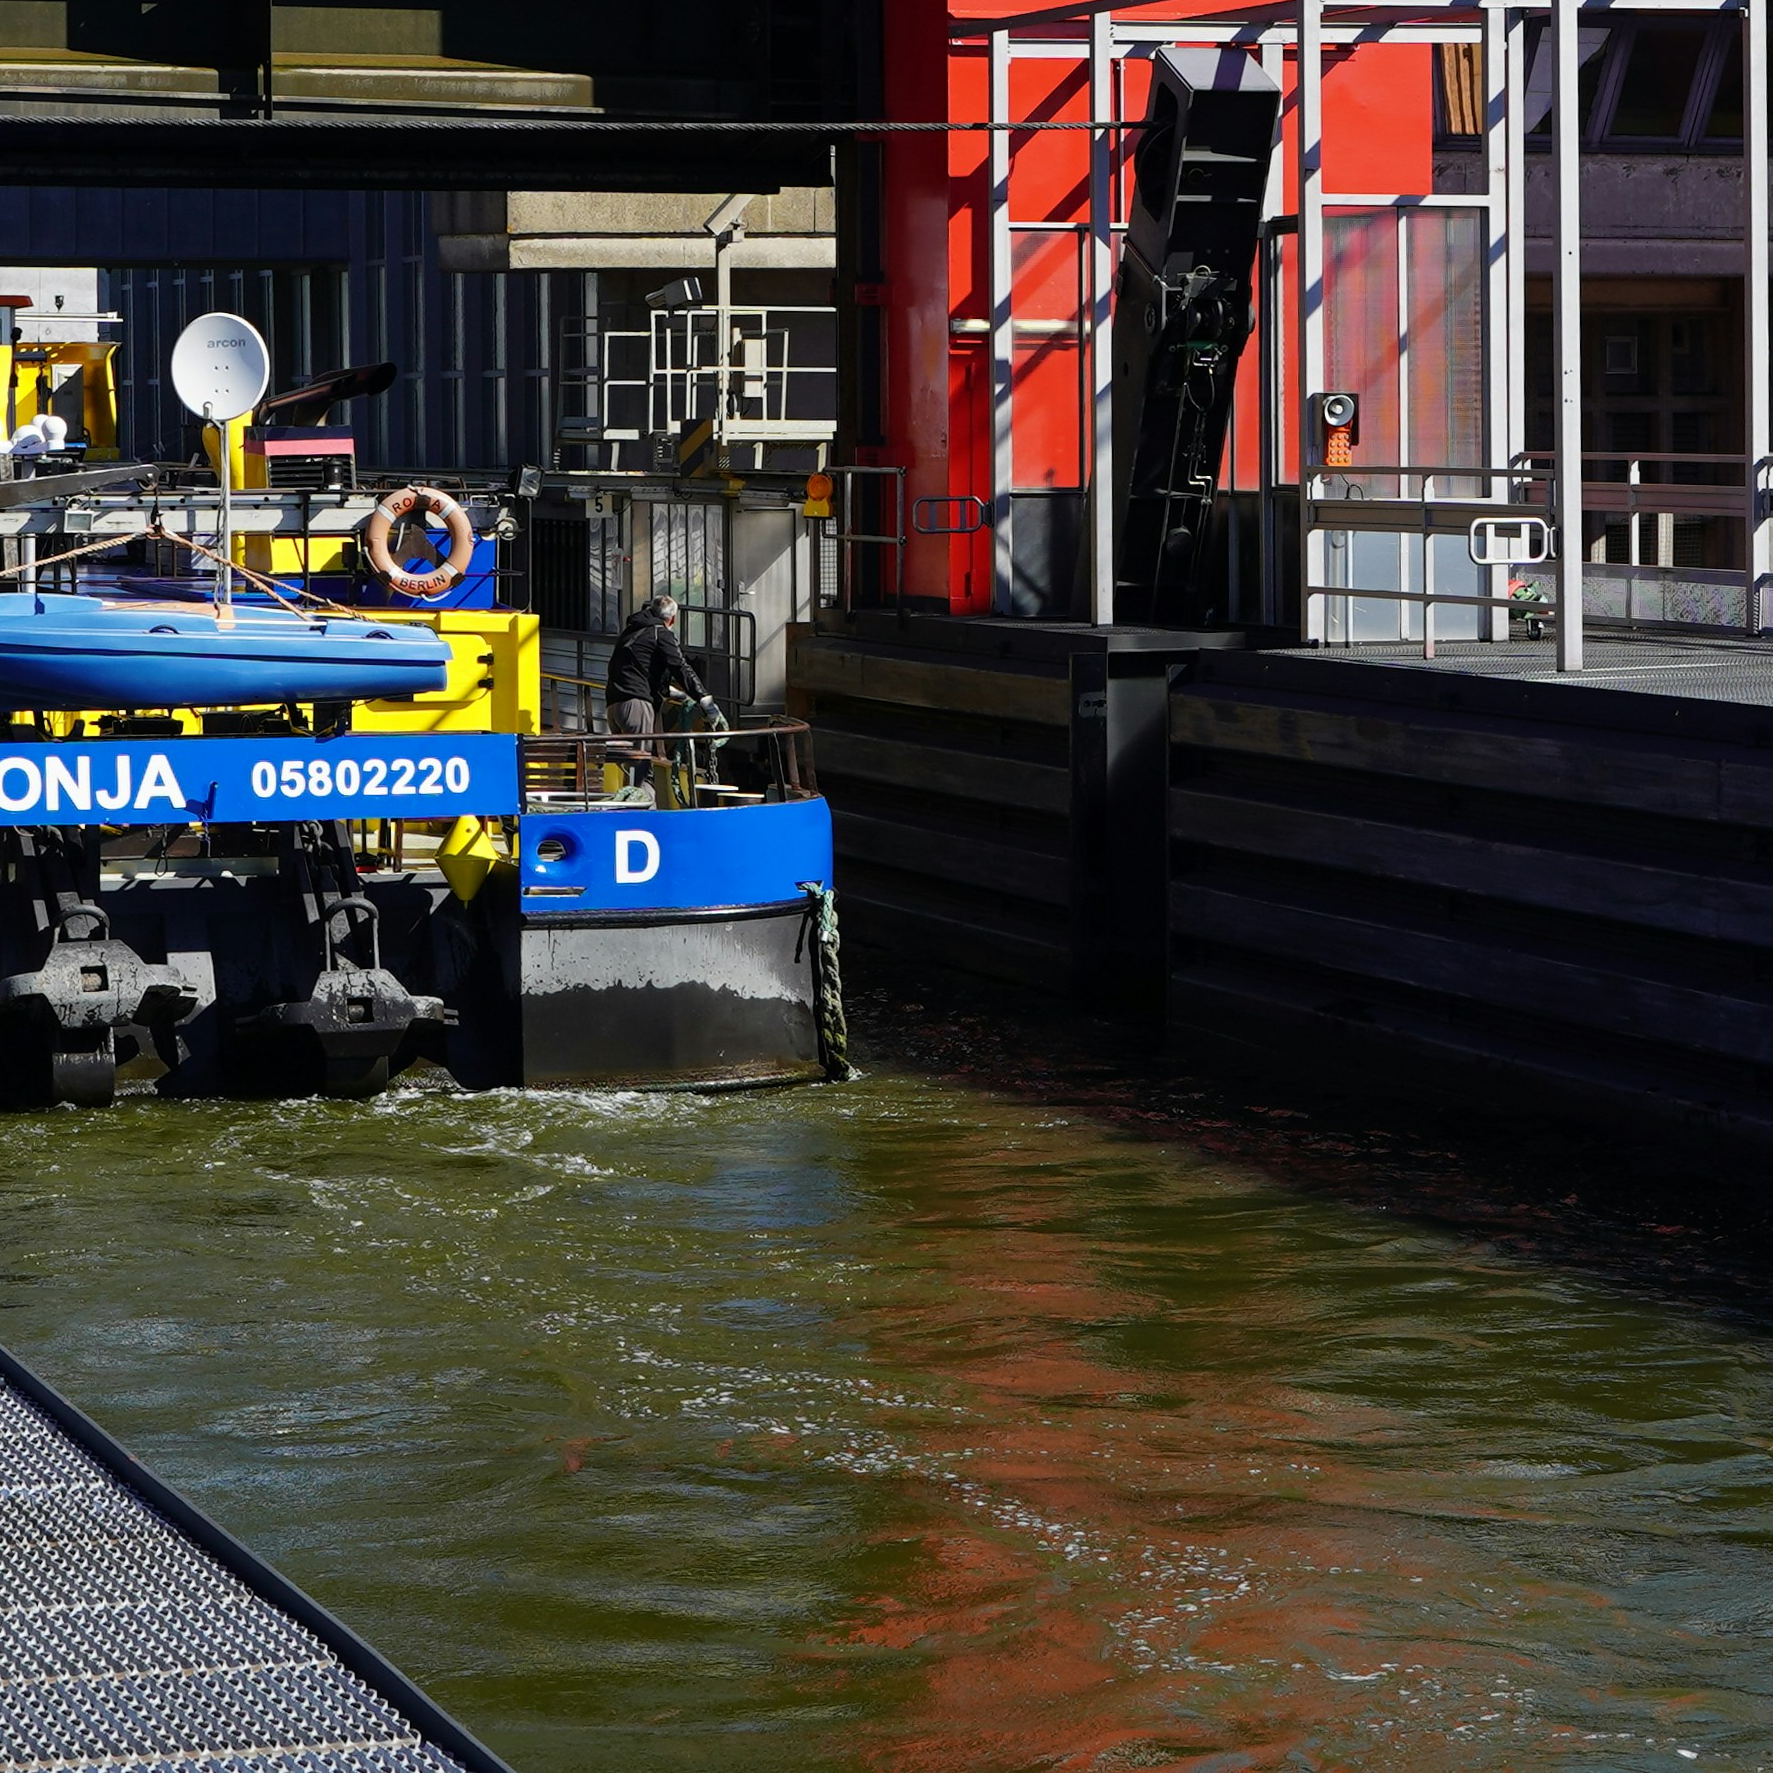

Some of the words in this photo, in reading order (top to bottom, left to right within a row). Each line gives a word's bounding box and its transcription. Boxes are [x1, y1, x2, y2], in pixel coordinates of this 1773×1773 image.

[207, 338, 246, 349] arcon
[392, 497, 442, 514] ROA
[594, 496, 604, 514] 5
[399, 574, 446, 591] BERLIN
[251, 755, 471, 799] 05802220
[615, 830, 661, 884] D
